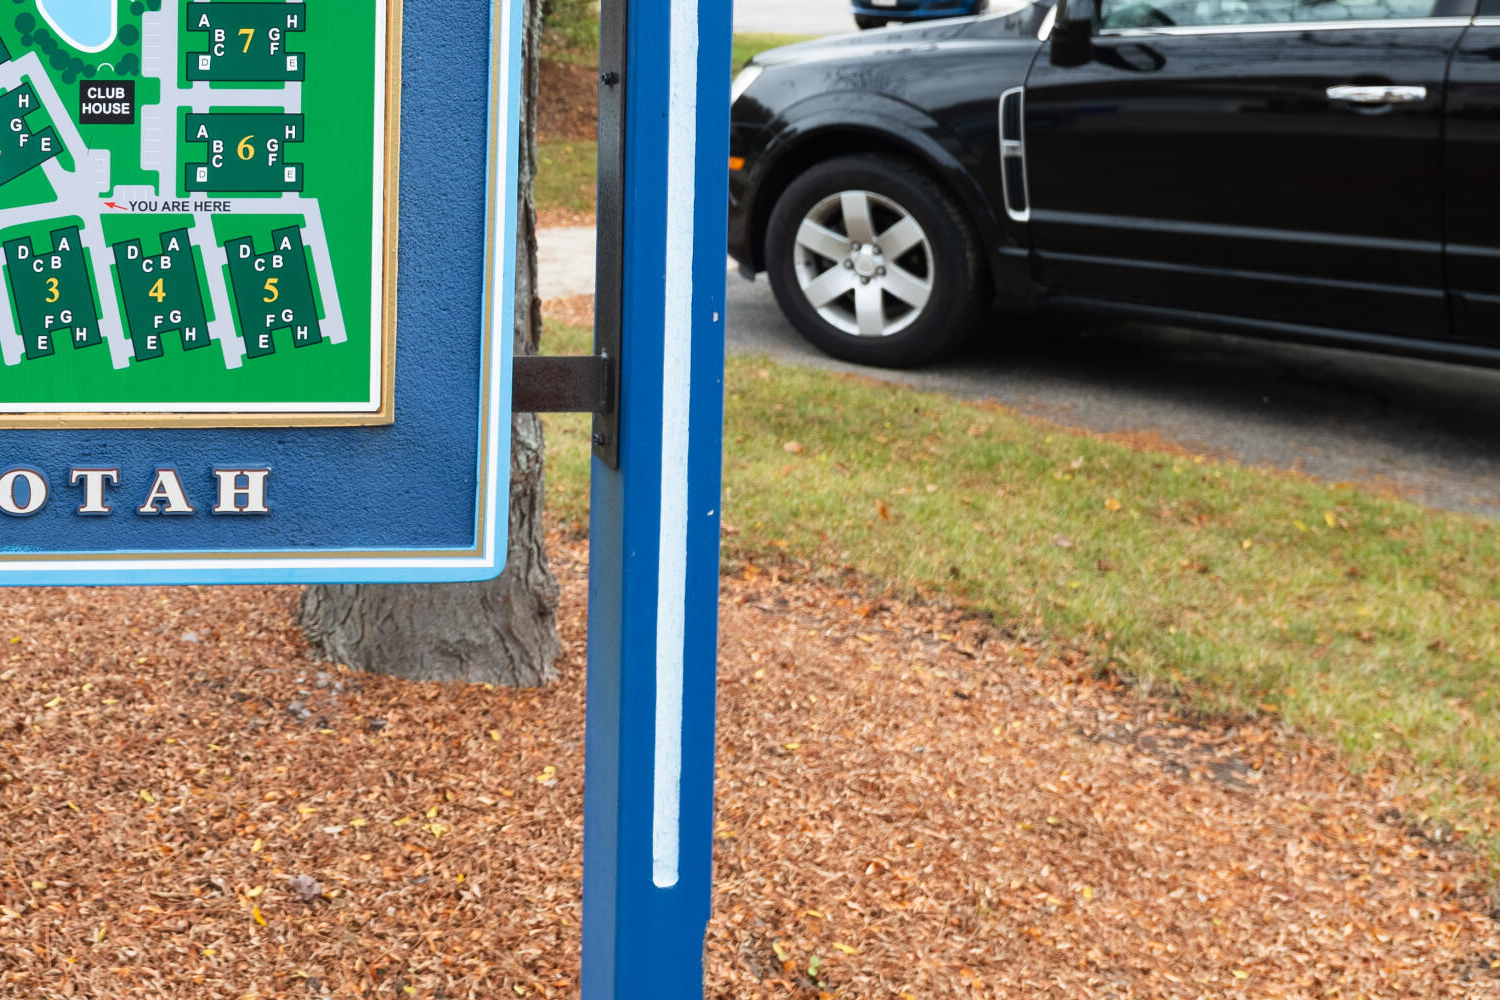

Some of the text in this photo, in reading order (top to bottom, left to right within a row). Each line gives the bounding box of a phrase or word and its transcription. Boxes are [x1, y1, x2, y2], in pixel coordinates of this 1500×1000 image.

[198, 13, 211, 28] A
[286, 14, 298, 29] H
[214, 28, 226, 42] B
[238, 28, 255, 54] 7
[213, 43, 225, 57] C
[87, 86, 125, 99] CLUB
[18, 93, 29, 108] H
[82, 102, 130, 115] HOUSE
[10, 118, 22, 132] G
[196, 124, 209, 139] A
[285, 125, 296, 139] H
[19, 133, 29, 147] F
[41, 137, 52, 152] E
[212, 139, 224, 154] B
[266, 138, 279, 152] G
[237, 135, 255, 161] 6
[211, 154, 223, 168] C
[268, 153, 278, 167] F
[128, 200, 232, 212] YOU ARE HERE
[58, 237, 70, 252] A
[167, 237, 180, 252] A
[279, 236, 292, 251] A
[18, 245, 29, 260] D
[127, 245, 139, 260] D
[239, 244, 251, 259] D
[32, 259, 44, 273] C
[51, 255, 62, 269] B
[254, 258, 266, 272] C
[272, 254, 284, 268] B
[45, 277, 60, 303] 3
[148, 277, 167, 303] 4
[263, 277, 279, 303] 5
[44, 315, 54, 329] F
[60, 309, 72, 324] G
[266, 314, 276, 328] F
[281, 308, 293, 323] G
[76, 327, 87, 342] H
[185, 327, 196, 341] H
[297, 326, 308, 340] H
[37, 335, 48, 350] E
[146, 335, 157, 350] E
[258, 334, 269, 349] E
